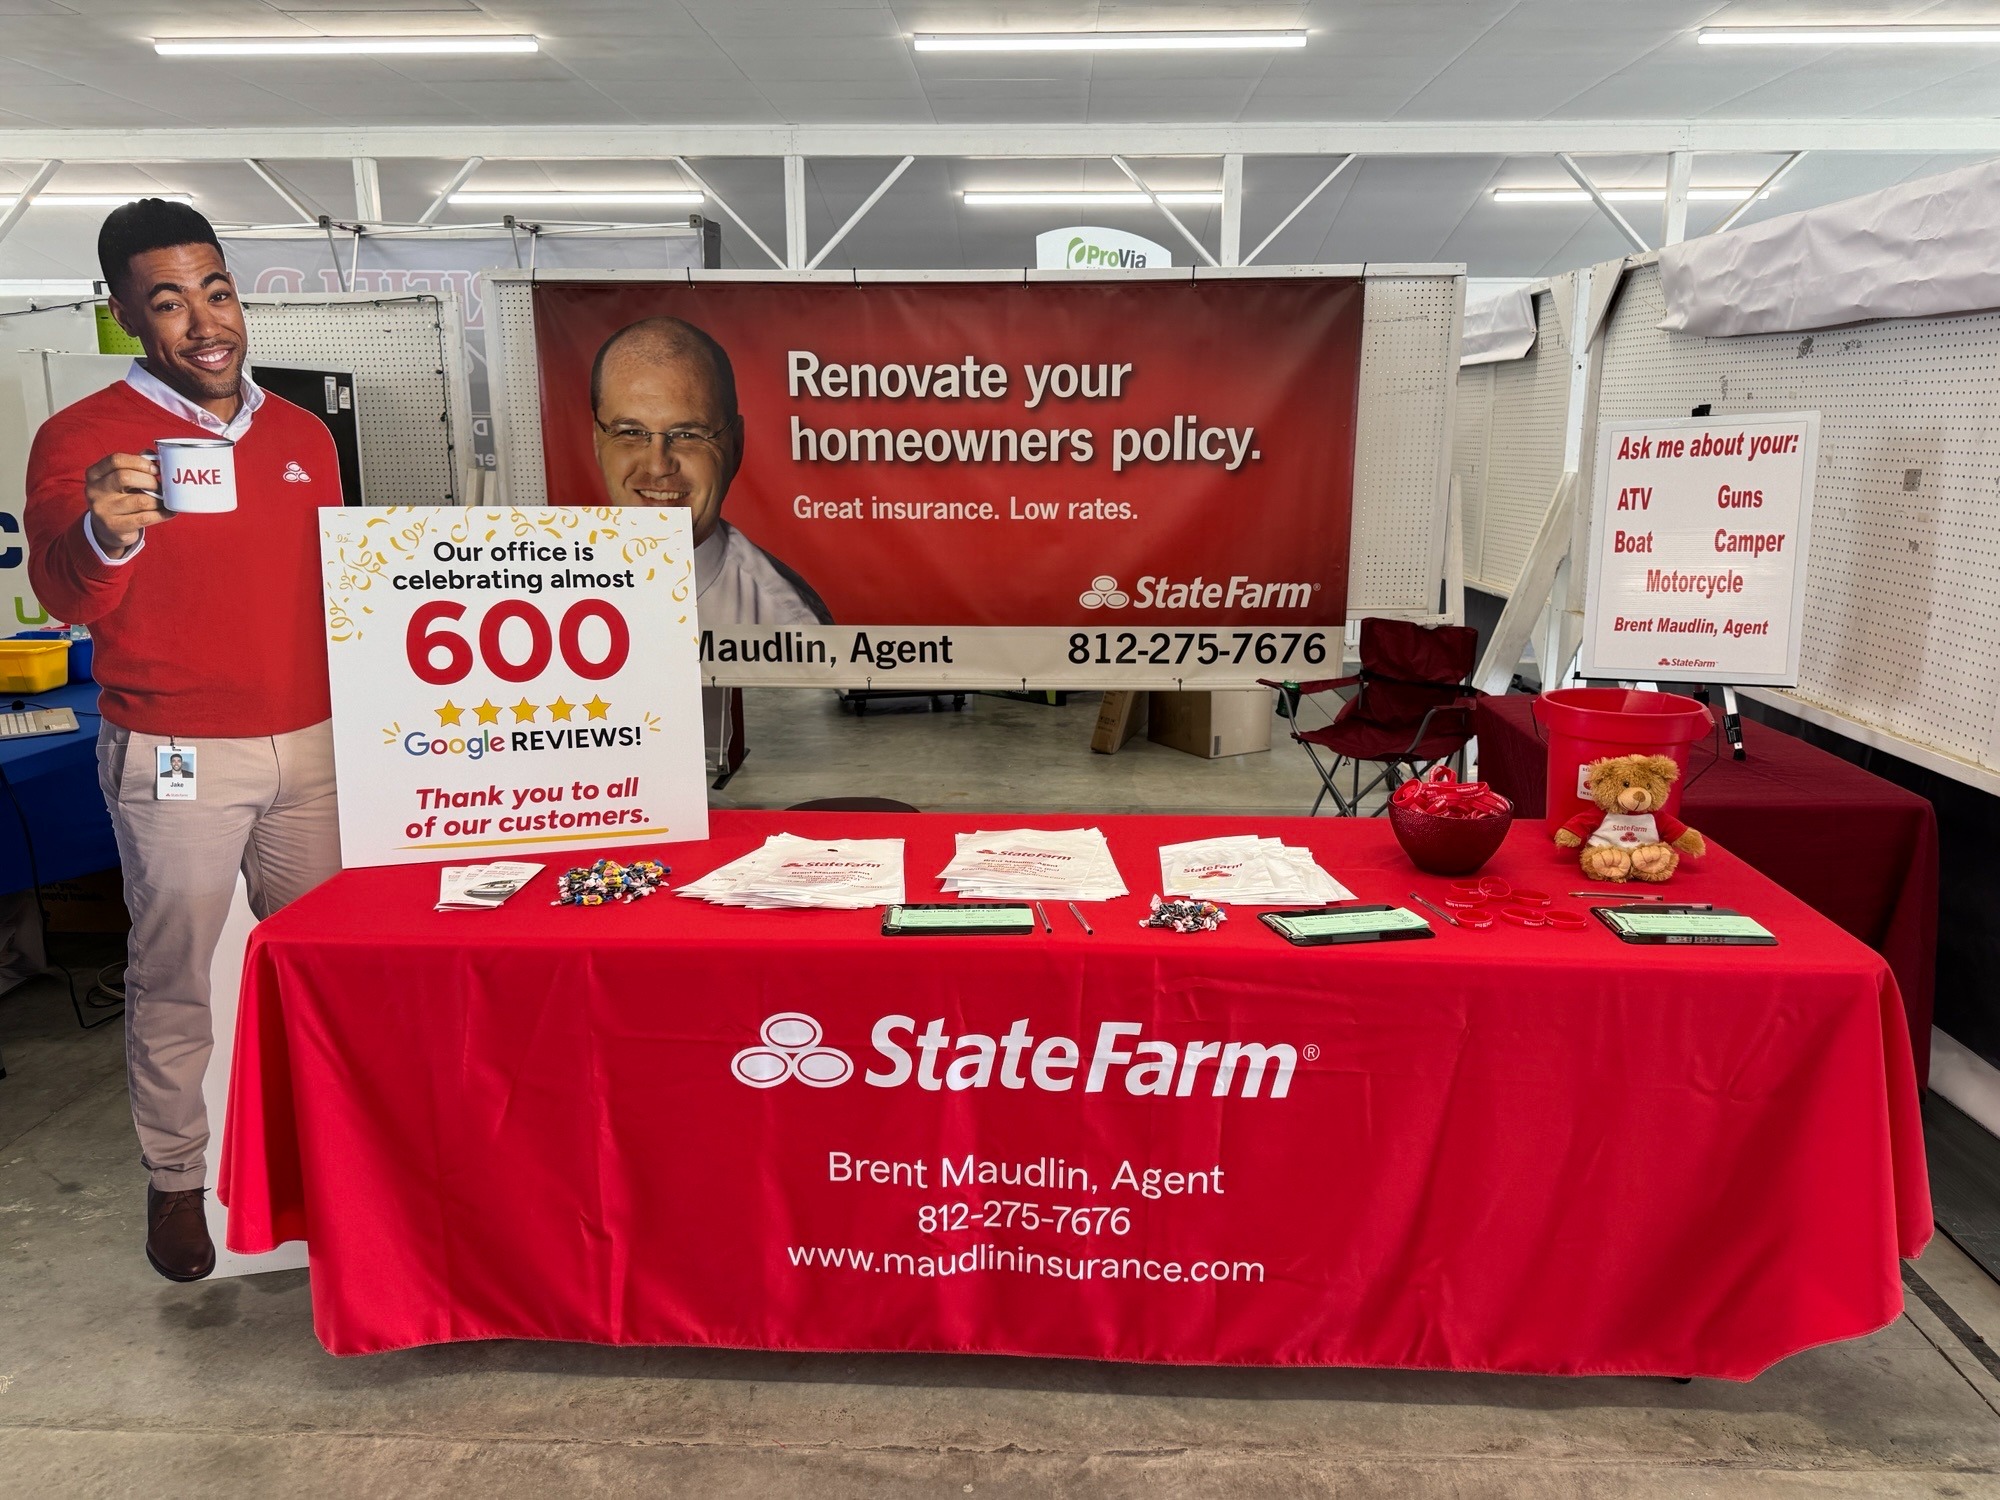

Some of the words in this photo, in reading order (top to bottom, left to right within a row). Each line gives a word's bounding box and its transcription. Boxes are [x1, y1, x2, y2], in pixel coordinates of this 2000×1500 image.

[1087, 245, 1147, 269] ProVia
[788, 351, 1007, 398] Renovate
[1024, 360, 1132, 408] your
[790, 416, 1094, 463] homeowners
[1113, 415, 1261, 471] policy.
[1617, 436, 1652, 460] Ask
[1656, 438, 1684, 458] me
[1690, 432, 1744, 457] about
[1748, 434, 1799, 461] your:
[172, 468, 221, 486] JAKE
[793, 496, 863, 520] Great
[872, 496, 1000, 520] insurance.
[1010, 498, 1059, 520] Low
[1068, 499, 1138, 520] rates.
[1617, 487, 1653, 511] ATV
[1718, 485, 1763, 508] Guns
[434, 542, 483, 562] Our
[491, 541, 567, 562] office
[574, 541, 594, 562] is
[1614, 531, 1653, 553] Boat
[1715, 529, 1785, 558] Camper
[393, 569, 542, 593] celebrating
[551, 568, 634, 588] almost
[1646, 568, 1743, 599] Motorcycle
[406, 598, 630, 685] 600
[1614, 617, 1653, 632] Brent
[1657, 618, 1717, 637] Maudlin,
[1723, 619, 1768, 638] Agent
[850, 632, 953, 669] Agent
[1068, 633, 1326, 664] 812-275-7676
[404, 730, 505, 760] Google
[512, 726, 642, 751] REVIEWS!
[416, 785, 504, 809] Thank
[513, 786, 563, 810] you
[572, 782, 600, 801] to
[607, 777, 639, 799] all
[406, 816, 438, 839] of
[444, 819, 491, 837] our
[499, 808, 651, 834] customers.
[829, 1152, 928, 1189] Brent
[942, 1155, 1098, 1194] Maudlin,
[1111, 1161, 1225, 1200] Agent
[918, 1201, 1131, 1236] 812-275-7676
[788, 1243, 1265, 1283] www.maudlininsurance.com
